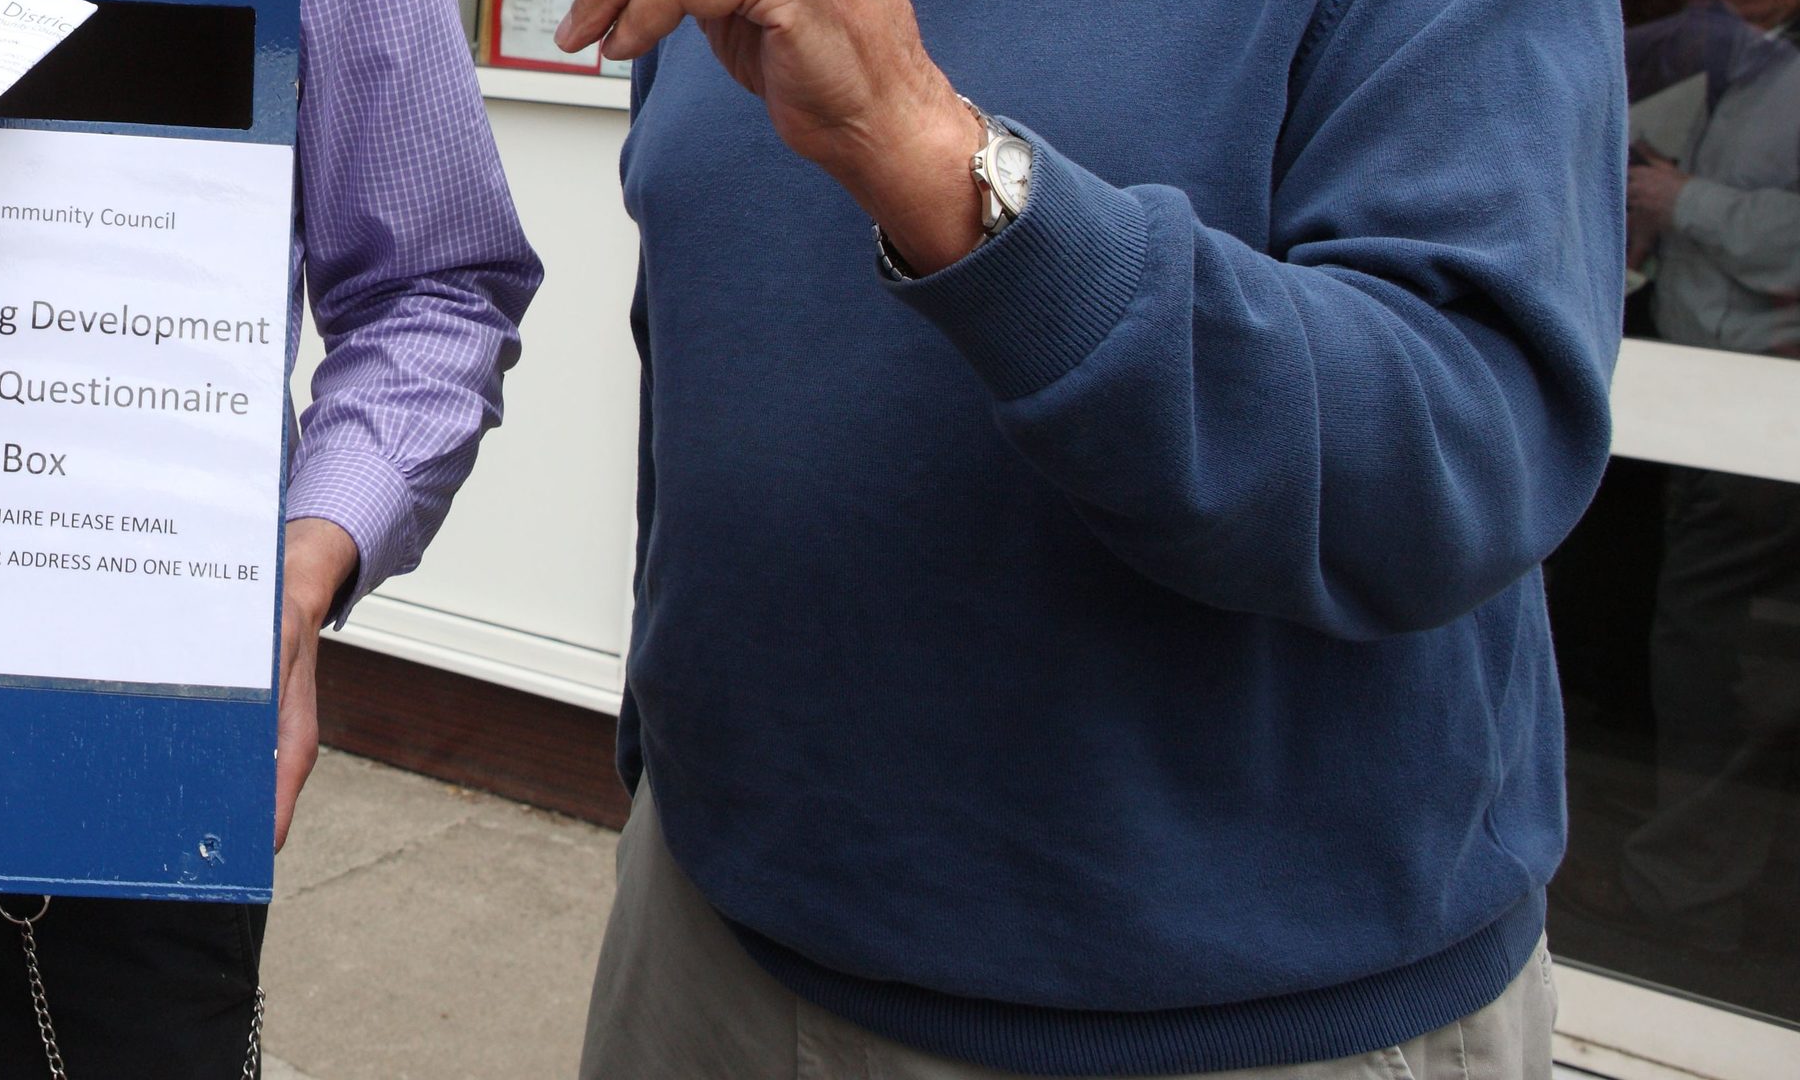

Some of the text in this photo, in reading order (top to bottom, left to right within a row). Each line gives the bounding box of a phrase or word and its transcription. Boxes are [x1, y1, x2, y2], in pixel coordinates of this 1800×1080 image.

[100, 208, 176, 230] Council
[31, 300, 270, 345] Development
[3, 443, 67, 476] Box
[50, 511, 114, 531] PLEASE
[121, 516, 178, 535] EMAIL
[7, 550, 91, 571] ADDRESS
[96, 556, 137, 573] AND
[142, 559, 182, 576] ONE
[188, 561, 232, 580] WILL
[237, 565, 259, 581] BE
